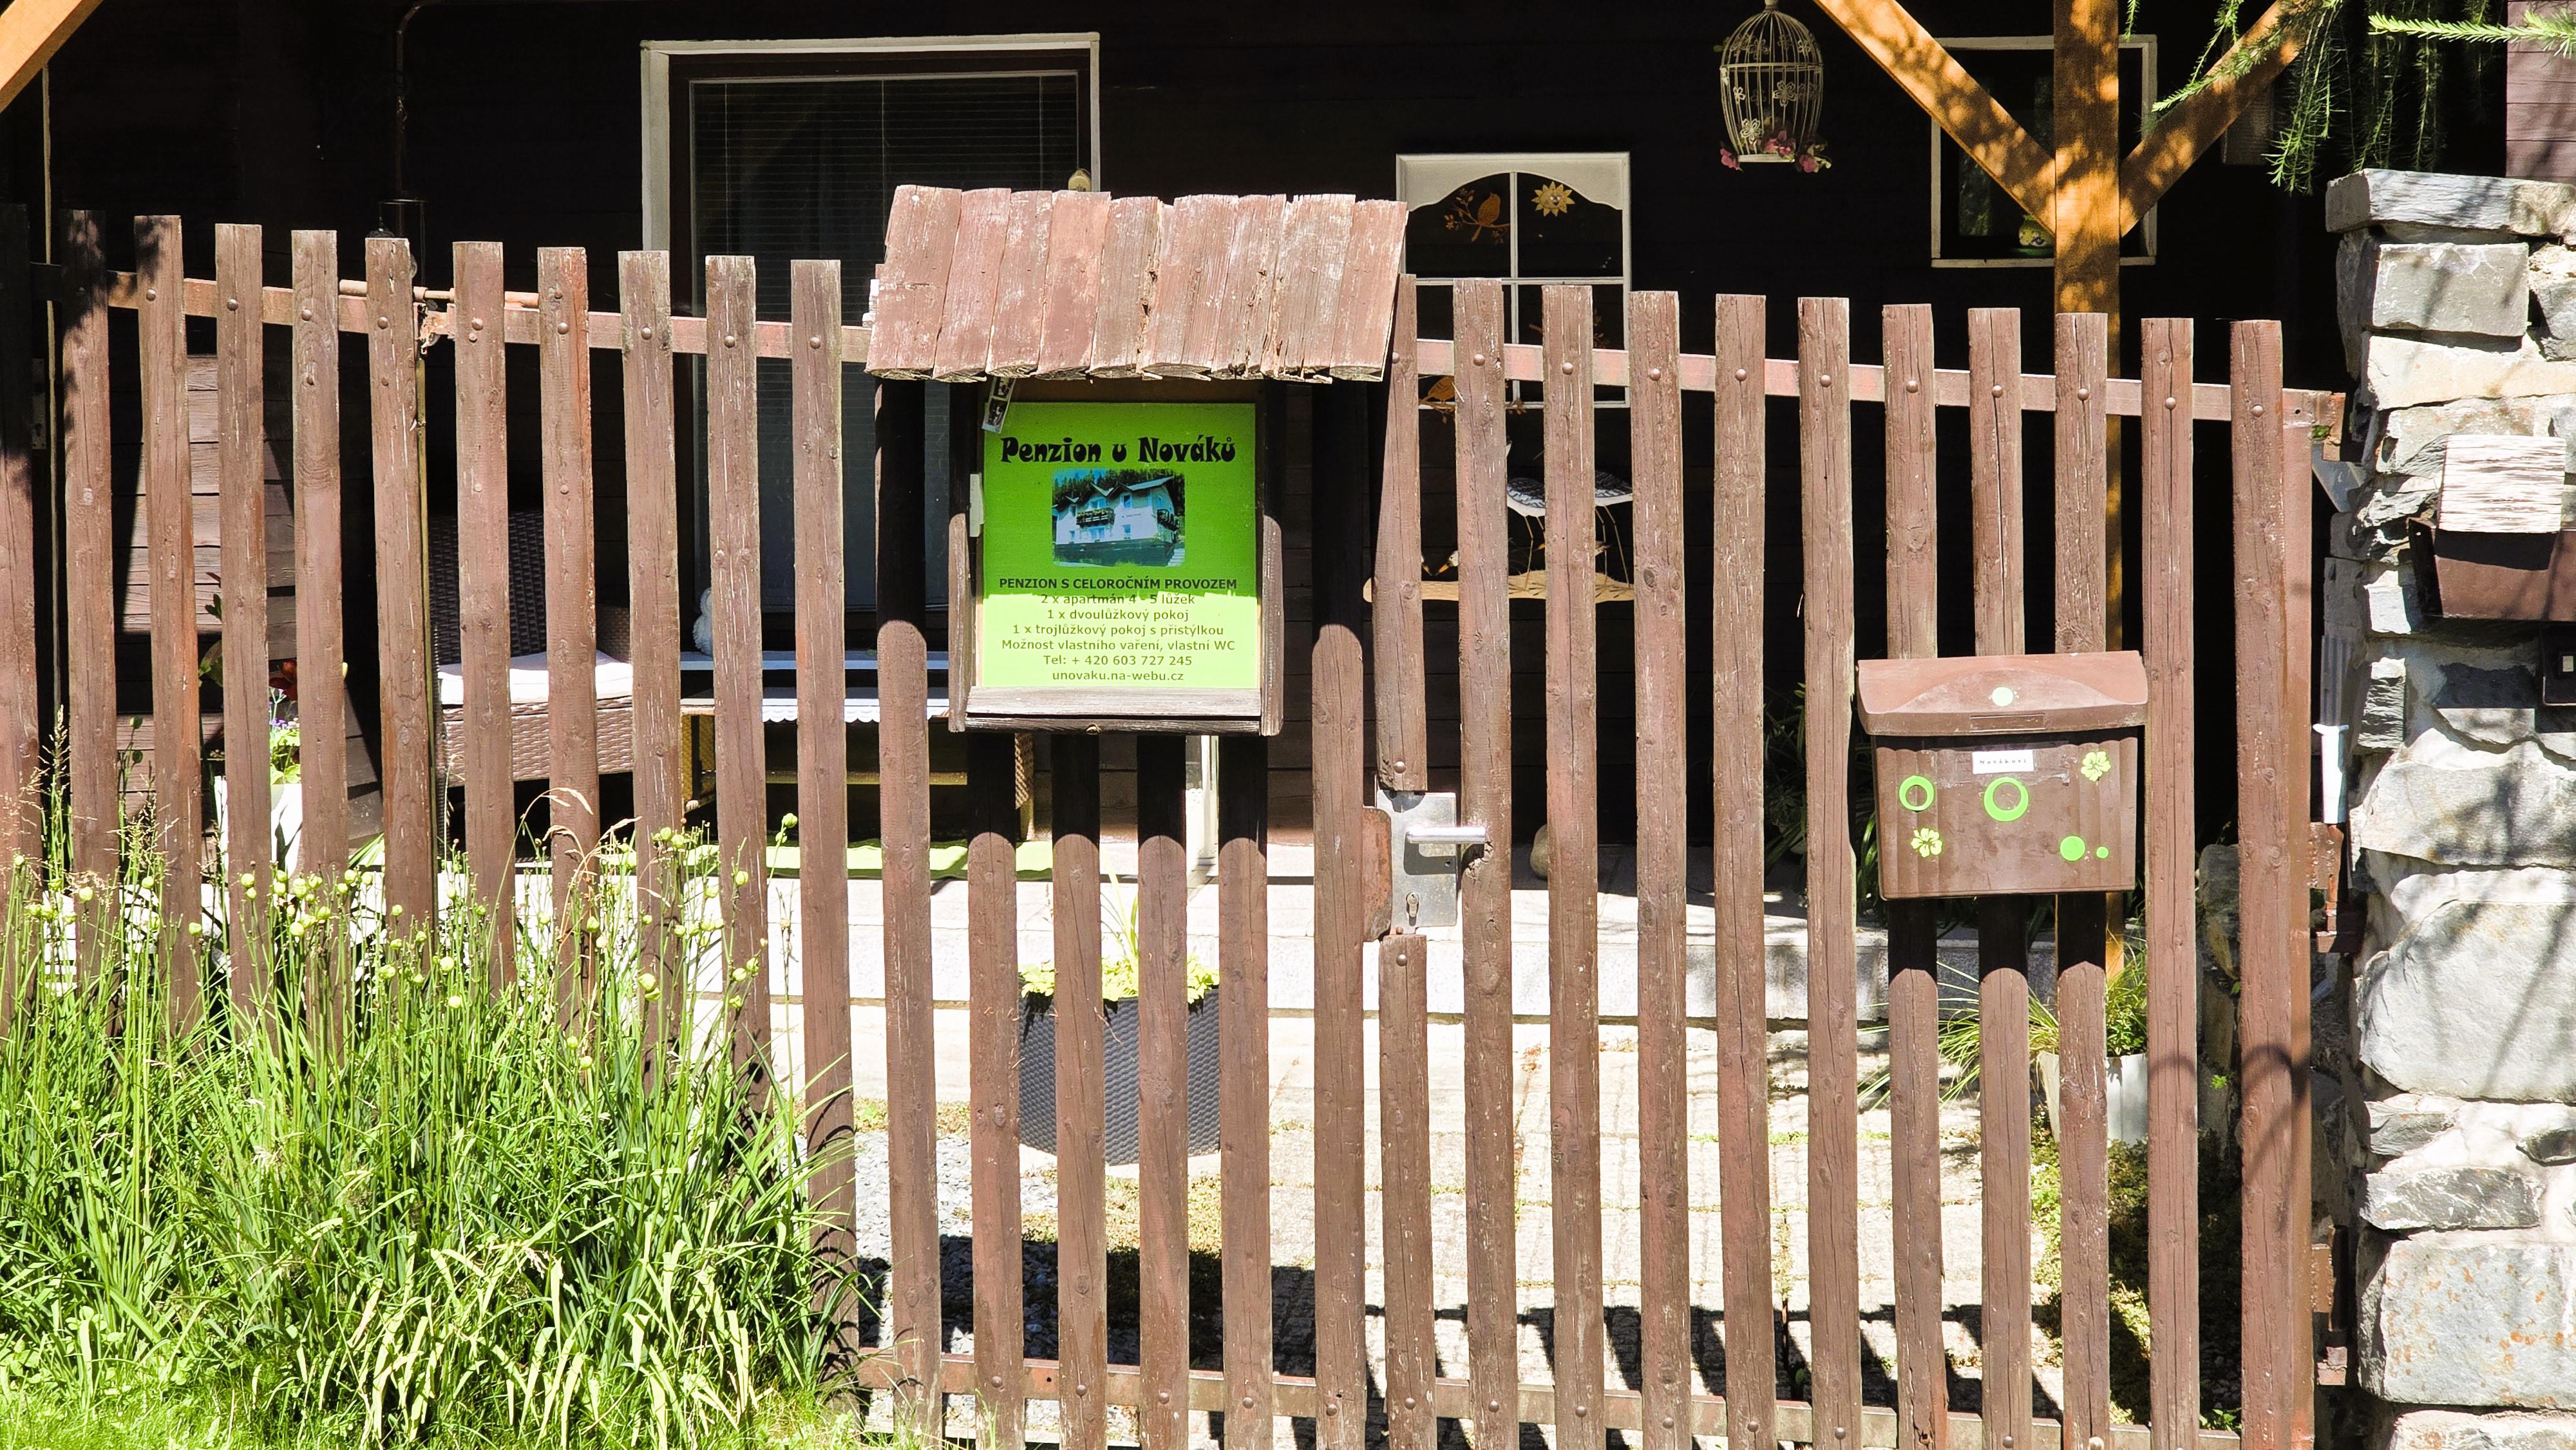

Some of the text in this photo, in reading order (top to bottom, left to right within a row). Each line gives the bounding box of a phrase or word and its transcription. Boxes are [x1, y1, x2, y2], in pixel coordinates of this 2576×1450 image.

[1000, 434, 1236, 463] Penzion u Nováků
[999, 575, 1237, 589] PENZION S CELOROČNÍM PROVOZEM
[1041, 594, 1048, 603] 2
[1063, 592, 1124, 606] apartmán
[1129, 594, 1136, 604] 4
[1150, 594, 1157, 604] 5
[1162, 592, 1195, 604] lůžek
[1047, 609, 1054, 619] 1
[1070, 608, 1150, 621] dvoulůžkový
[1153, 609, 1188, 621] pokoj
[1013, 624, 1019, 634] 1
[1036, 623, 1106, 637] trojlůžkový
[1111, 625, 1146, 637] pokoj
[1002, 638, 1235, 652] Možnost vlastního vaření, vlastní WC
[1043, 655, 1192, 666] Tel: + 420 603 727 245
[1052, 670, 1184, 681] unovaku.na-webu.cz
